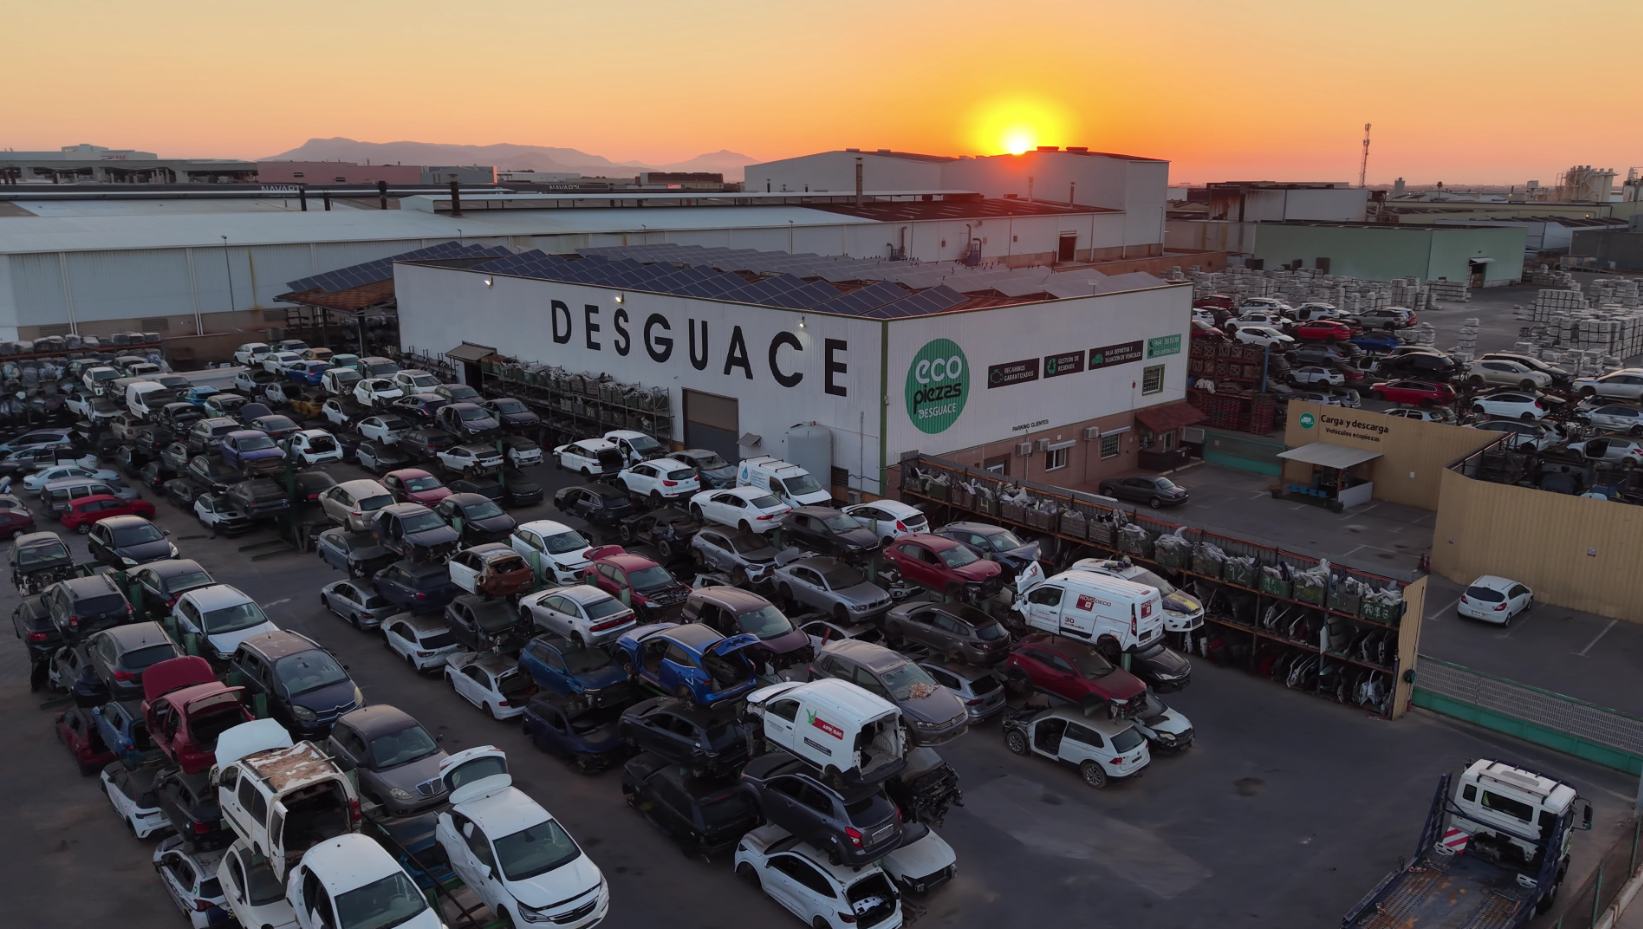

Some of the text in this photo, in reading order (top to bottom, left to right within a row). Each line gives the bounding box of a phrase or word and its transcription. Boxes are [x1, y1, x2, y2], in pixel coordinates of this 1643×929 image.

[551, 299, 847, 397] DESGUACE
[1004, 364, 1026, 374] RECAMBIOS
[1004, 370, 1034, 382] GARANTIZADOS
[913, 382, 962, 415] piezas
[918, 403, 957, 419] DESGUACE
[1012, 418, 1050, 432] PARKING CLIENTES
[1320, 414, 1389, 434] Carga y descarga
[1353, 432, 1381, 442] ecopiezas
